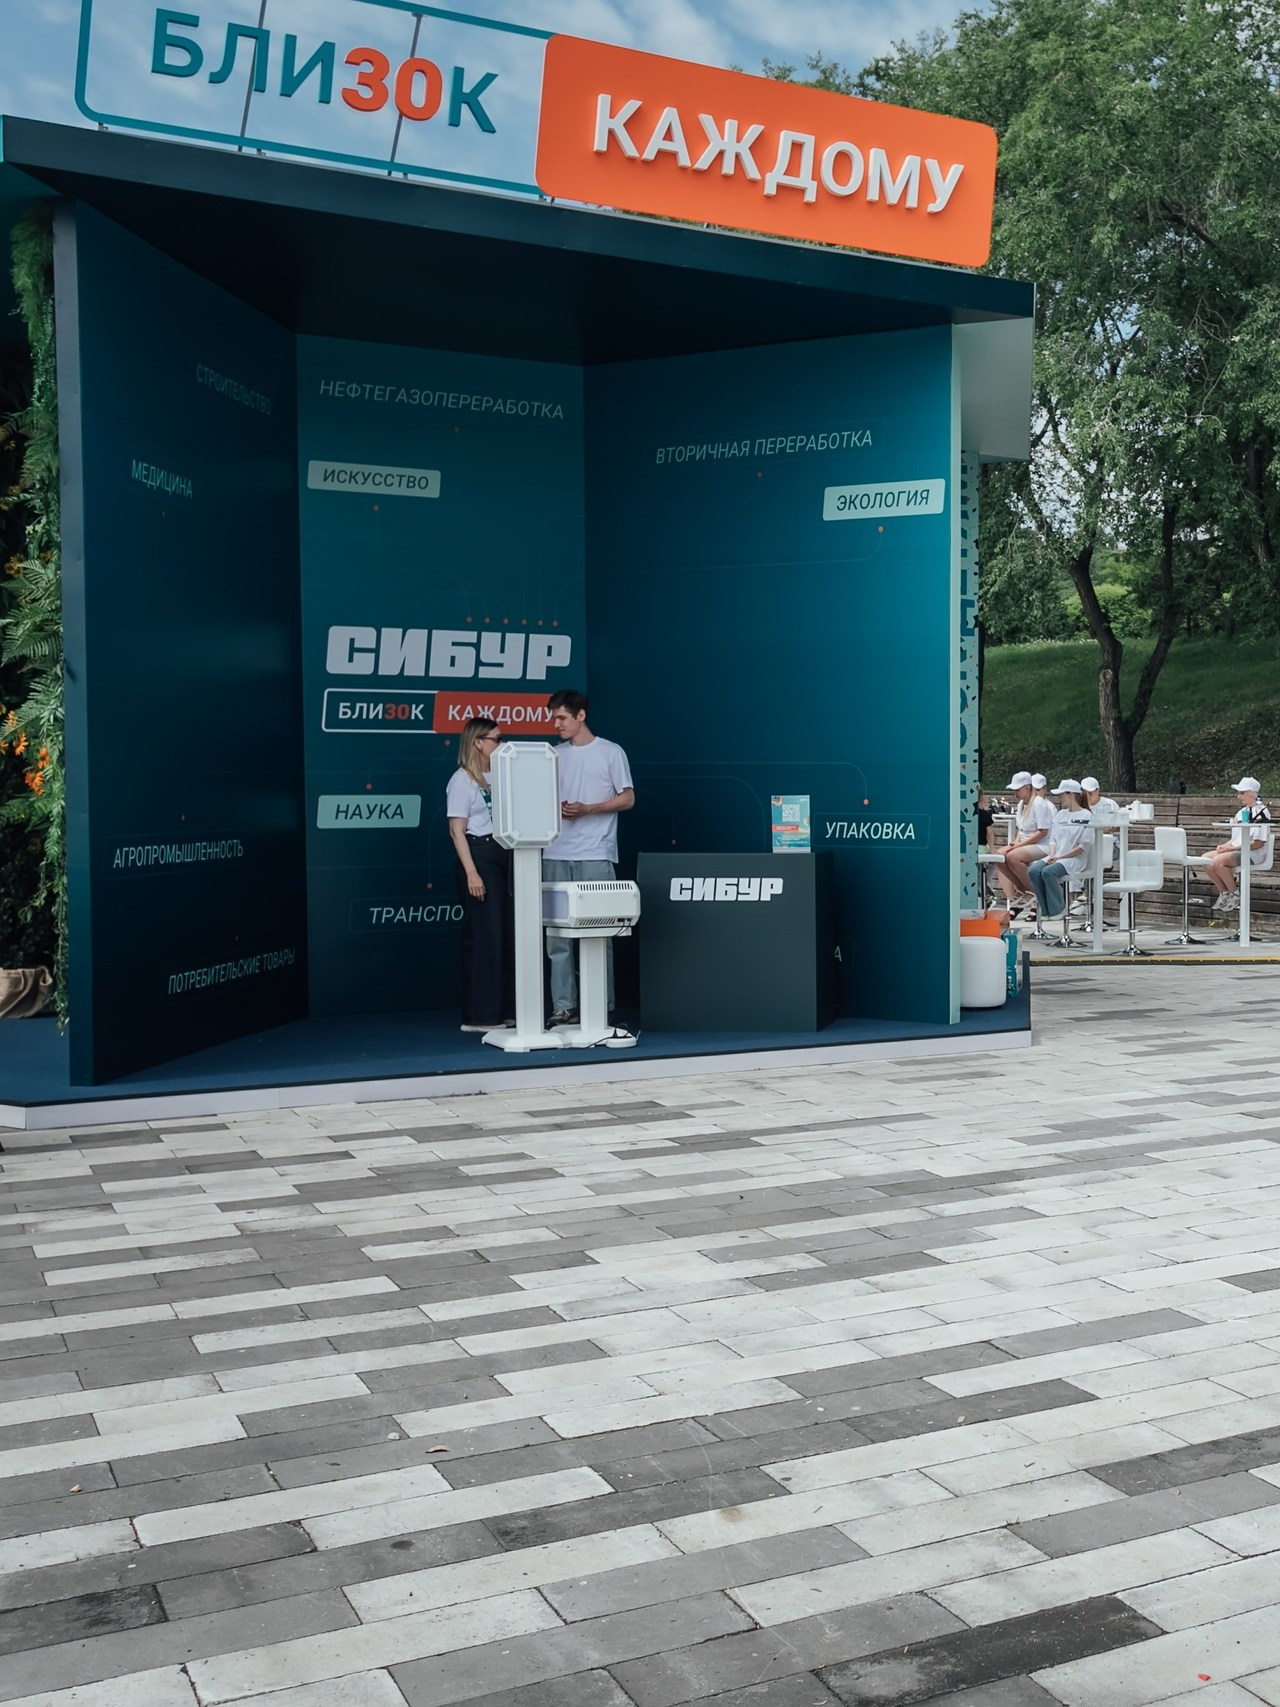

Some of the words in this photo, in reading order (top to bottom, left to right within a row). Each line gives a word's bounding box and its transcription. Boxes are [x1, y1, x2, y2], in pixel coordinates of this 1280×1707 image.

[593, 93, 965, 214] КАЖДОМУ
[196, 363, 272, 415] СТРОИТЕЛЬСТВО
[319, 379, 564, 420] НЕФТЕГАЗОПЕРЕРАБОТКА
[655, 440, 750, 464] ВТОРИЧНАЯ
[754, 429, 873, 455] ПЕРЕРАБОТКА
[131, 458, 193, 499] МЕДИЦИНА
[322, 468, 430, 491] ИСКУССТВО
[836, 488, 930, 512] ЭКОЛОГИЯ
[326, 625, 572, 680] СИБУР
[335, 803, 405, 821] НАУКА
[824, 821, 916, 840] УПАКОВКА
[113, 839, 245, 869] АГРОПРОМЫШЛЕННОСТЬ
[669, 877, 784, 901] СИБУР
[369, 904, 465, 924] ТРАНСПО
[168, 955, 261, 995] ПОТРЕБИТЕЛЬСКИЕ
[262, 948, 296, 971] ТОВАРЫ
